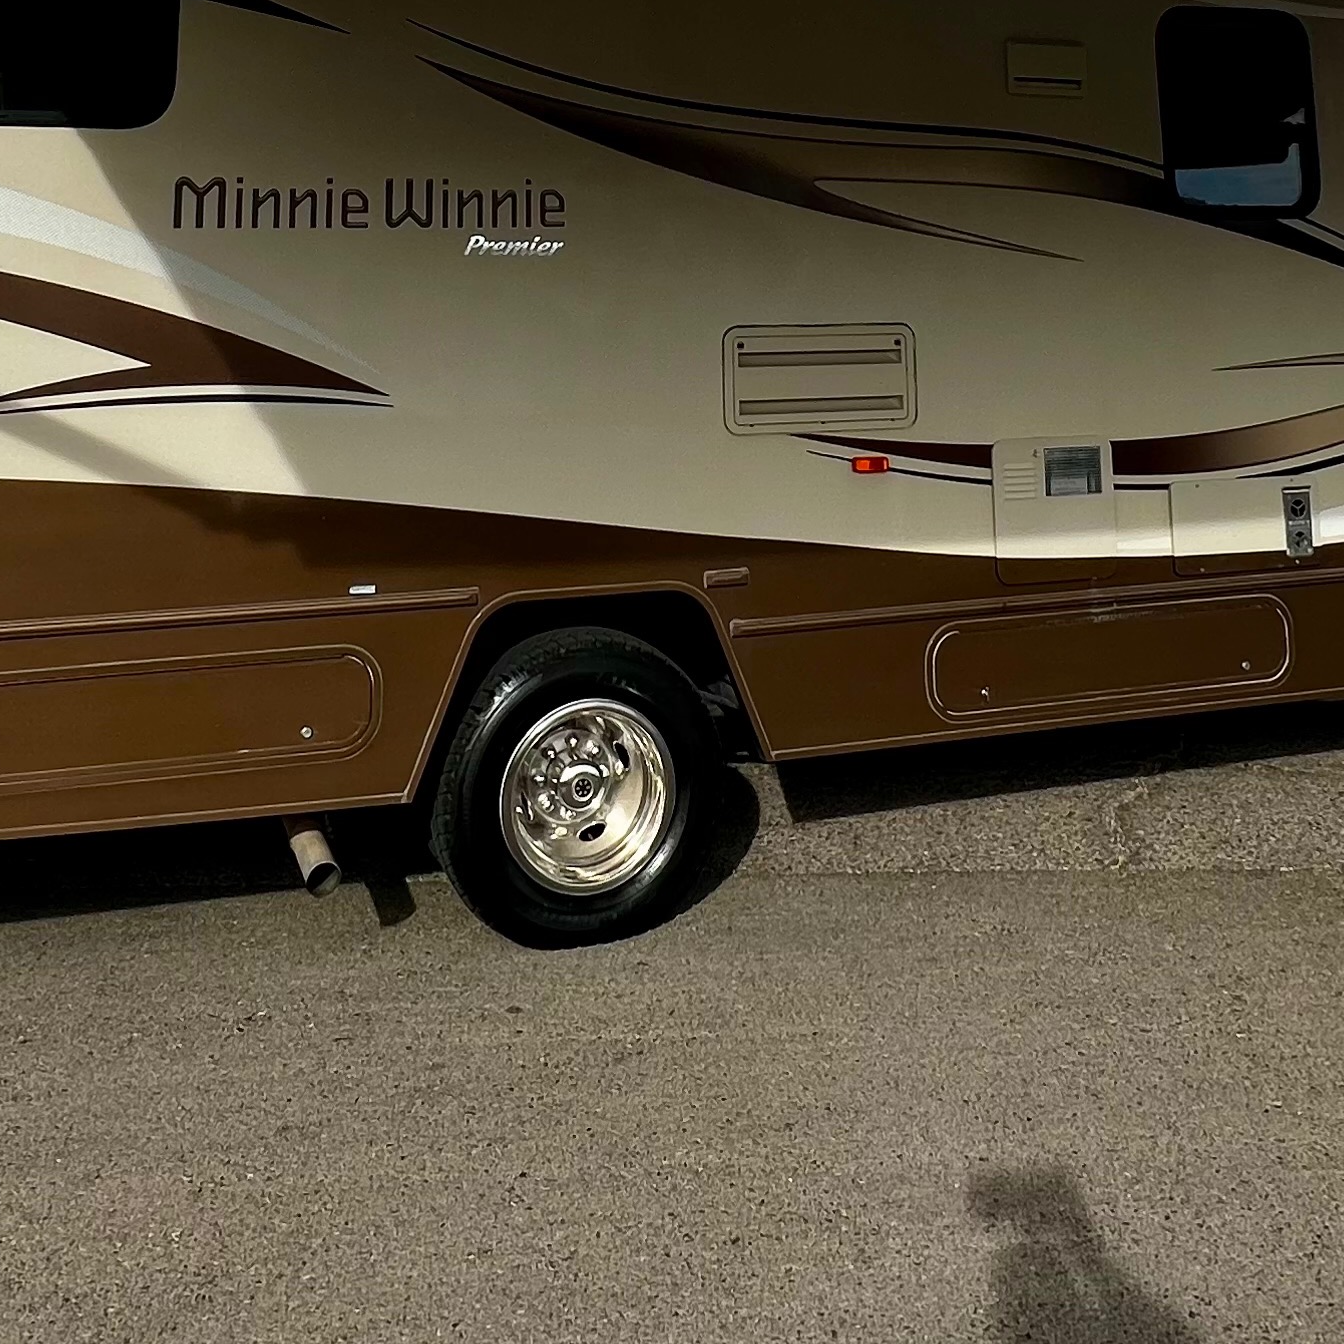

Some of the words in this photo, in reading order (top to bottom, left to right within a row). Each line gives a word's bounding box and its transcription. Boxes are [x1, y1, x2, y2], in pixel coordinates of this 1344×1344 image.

[172, 176, 369, 230] Minnie
[383, 176, 567, 230] Winnie
[464, 233, 564, 256] Premier
